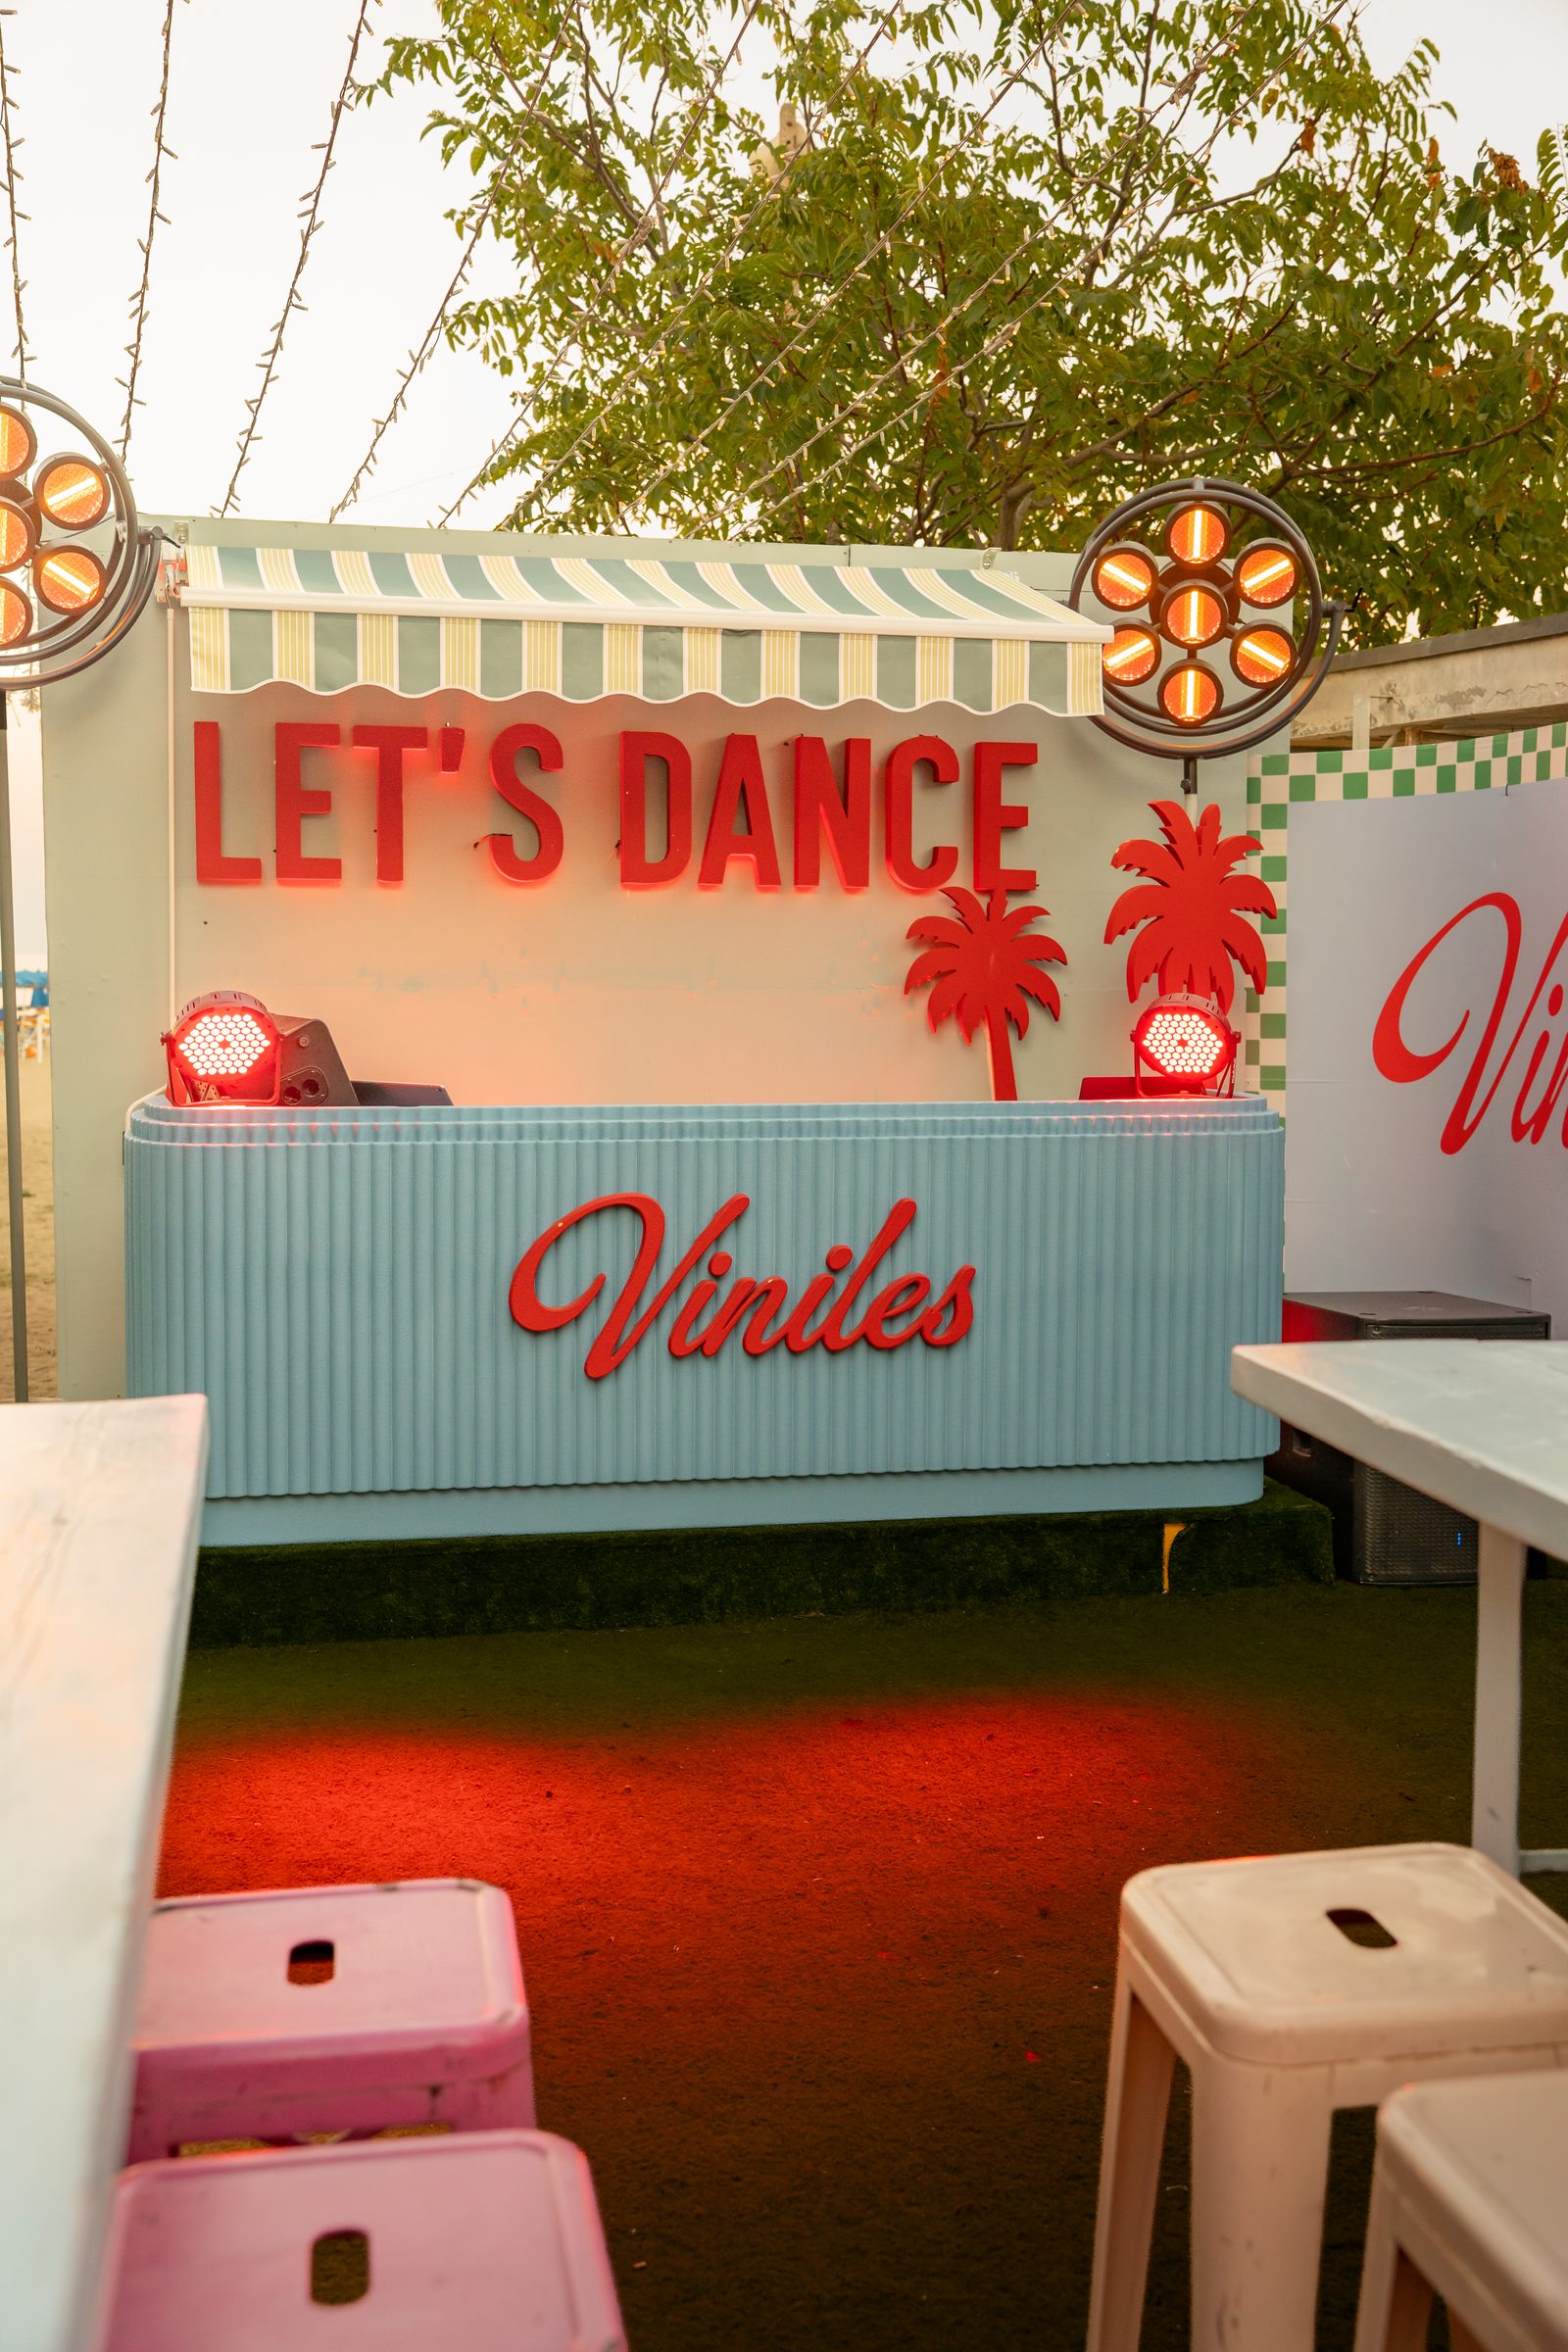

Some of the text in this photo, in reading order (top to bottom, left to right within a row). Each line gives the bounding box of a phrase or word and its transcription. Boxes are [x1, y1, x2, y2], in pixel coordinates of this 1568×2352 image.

[193, 721, 1039, 895] LET'S DANCE
[508, 1192, 976, 1379] Viniles
